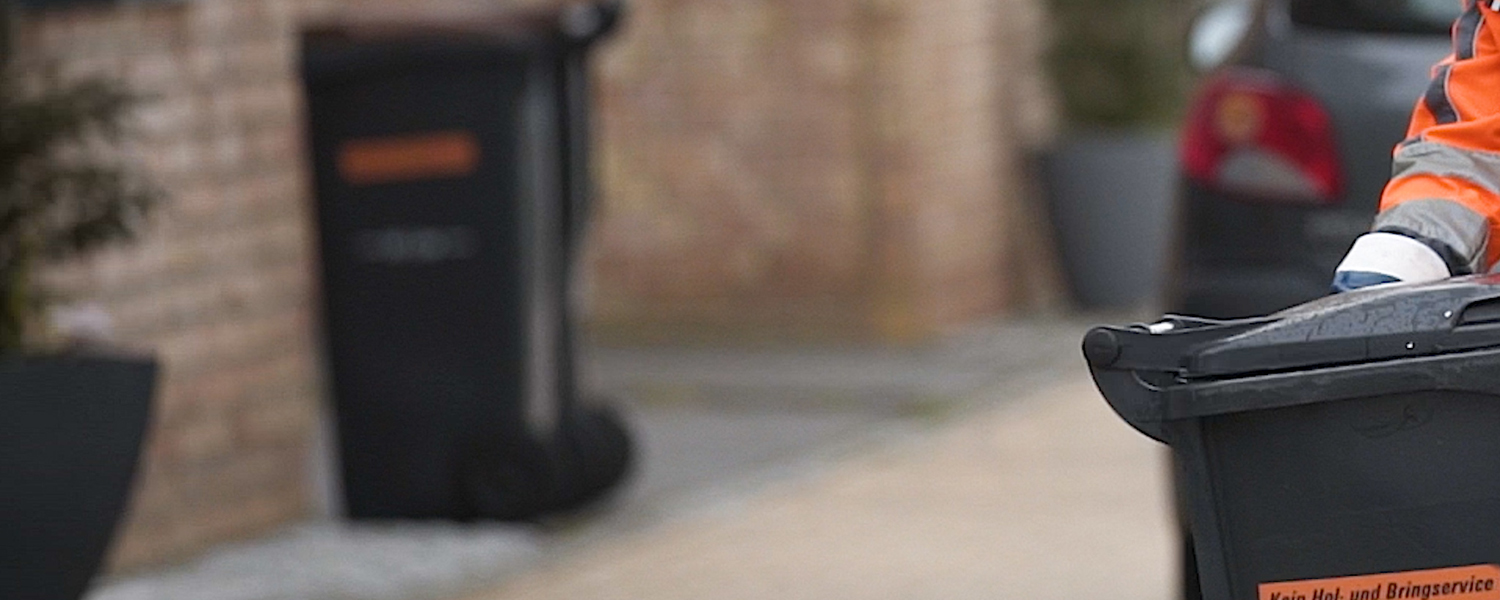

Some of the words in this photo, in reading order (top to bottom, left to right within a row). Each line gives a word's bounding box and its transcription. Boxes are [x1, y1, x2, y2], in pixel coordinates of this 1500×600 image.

[1312, 587, 1344, 600] Hol-
[1350, 584, 1381, 600] und
[1386, 575, 1494, 599] Bringservice
